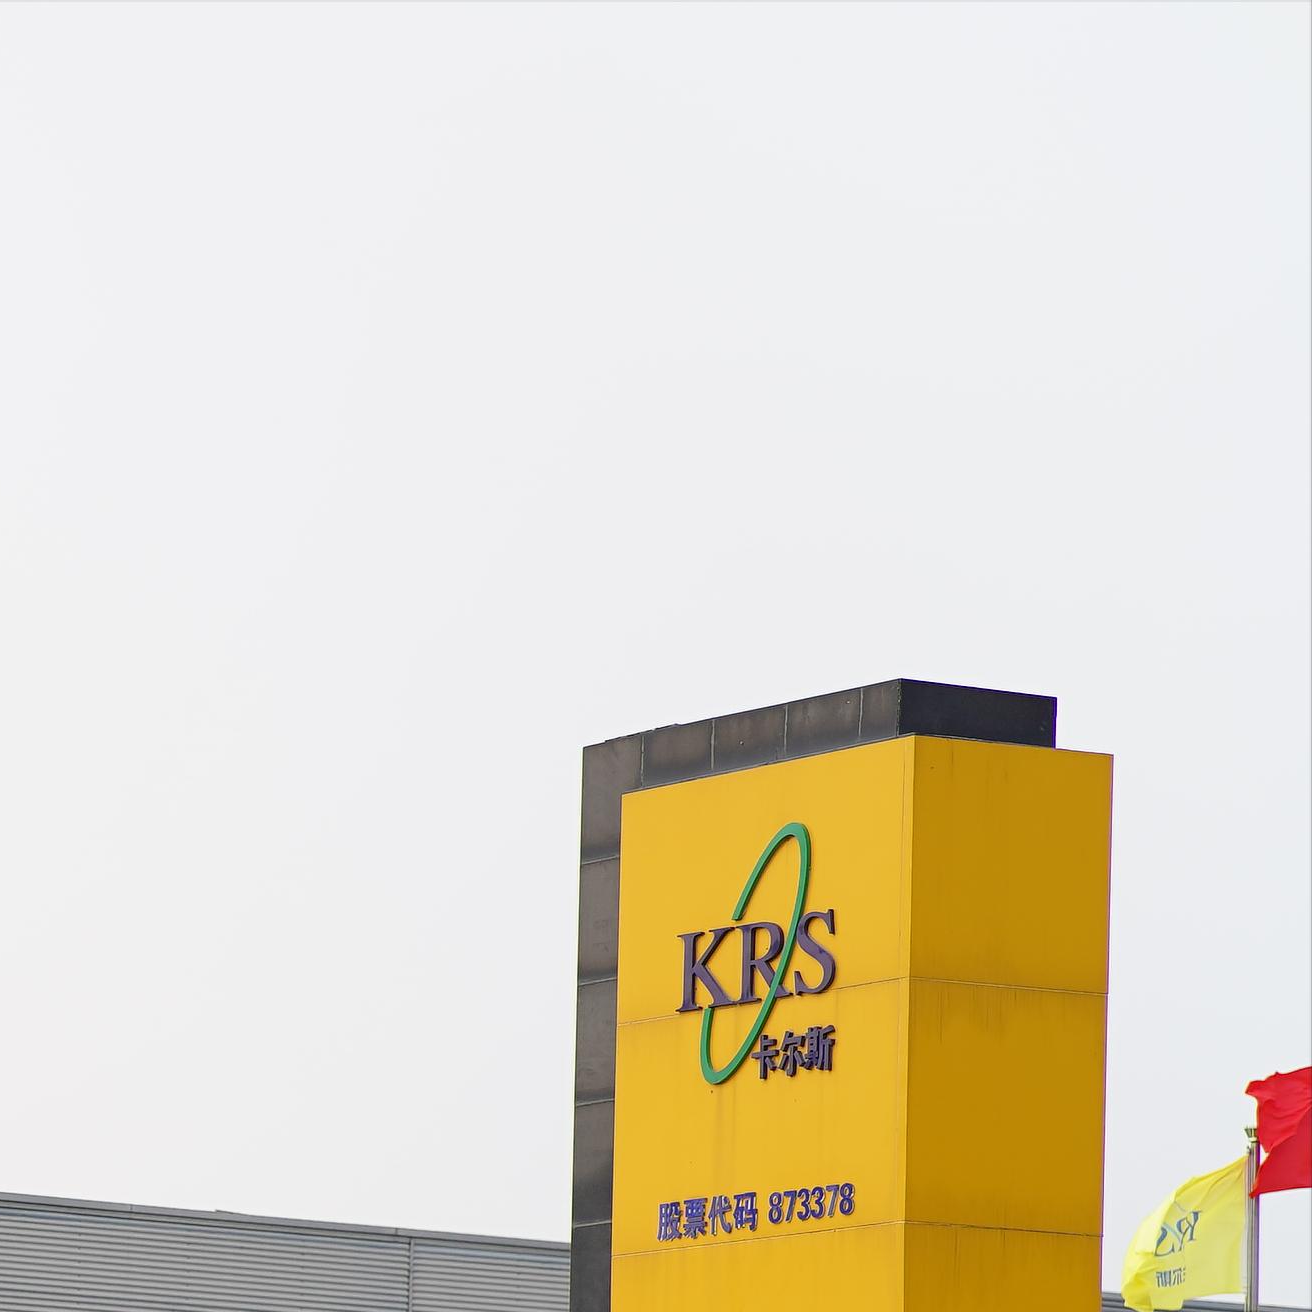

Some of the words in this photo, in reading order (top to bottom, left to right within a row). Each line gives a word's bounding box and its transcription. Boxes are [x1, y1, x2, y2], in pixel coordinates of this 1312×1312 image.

[675, 908, 837, 1013] KRS
[751, 1025, 837, 1079] 卡尔斯
[657, 1191, 759, 1241] 股票代码
[768, 1182, 855, 1224] 873378
